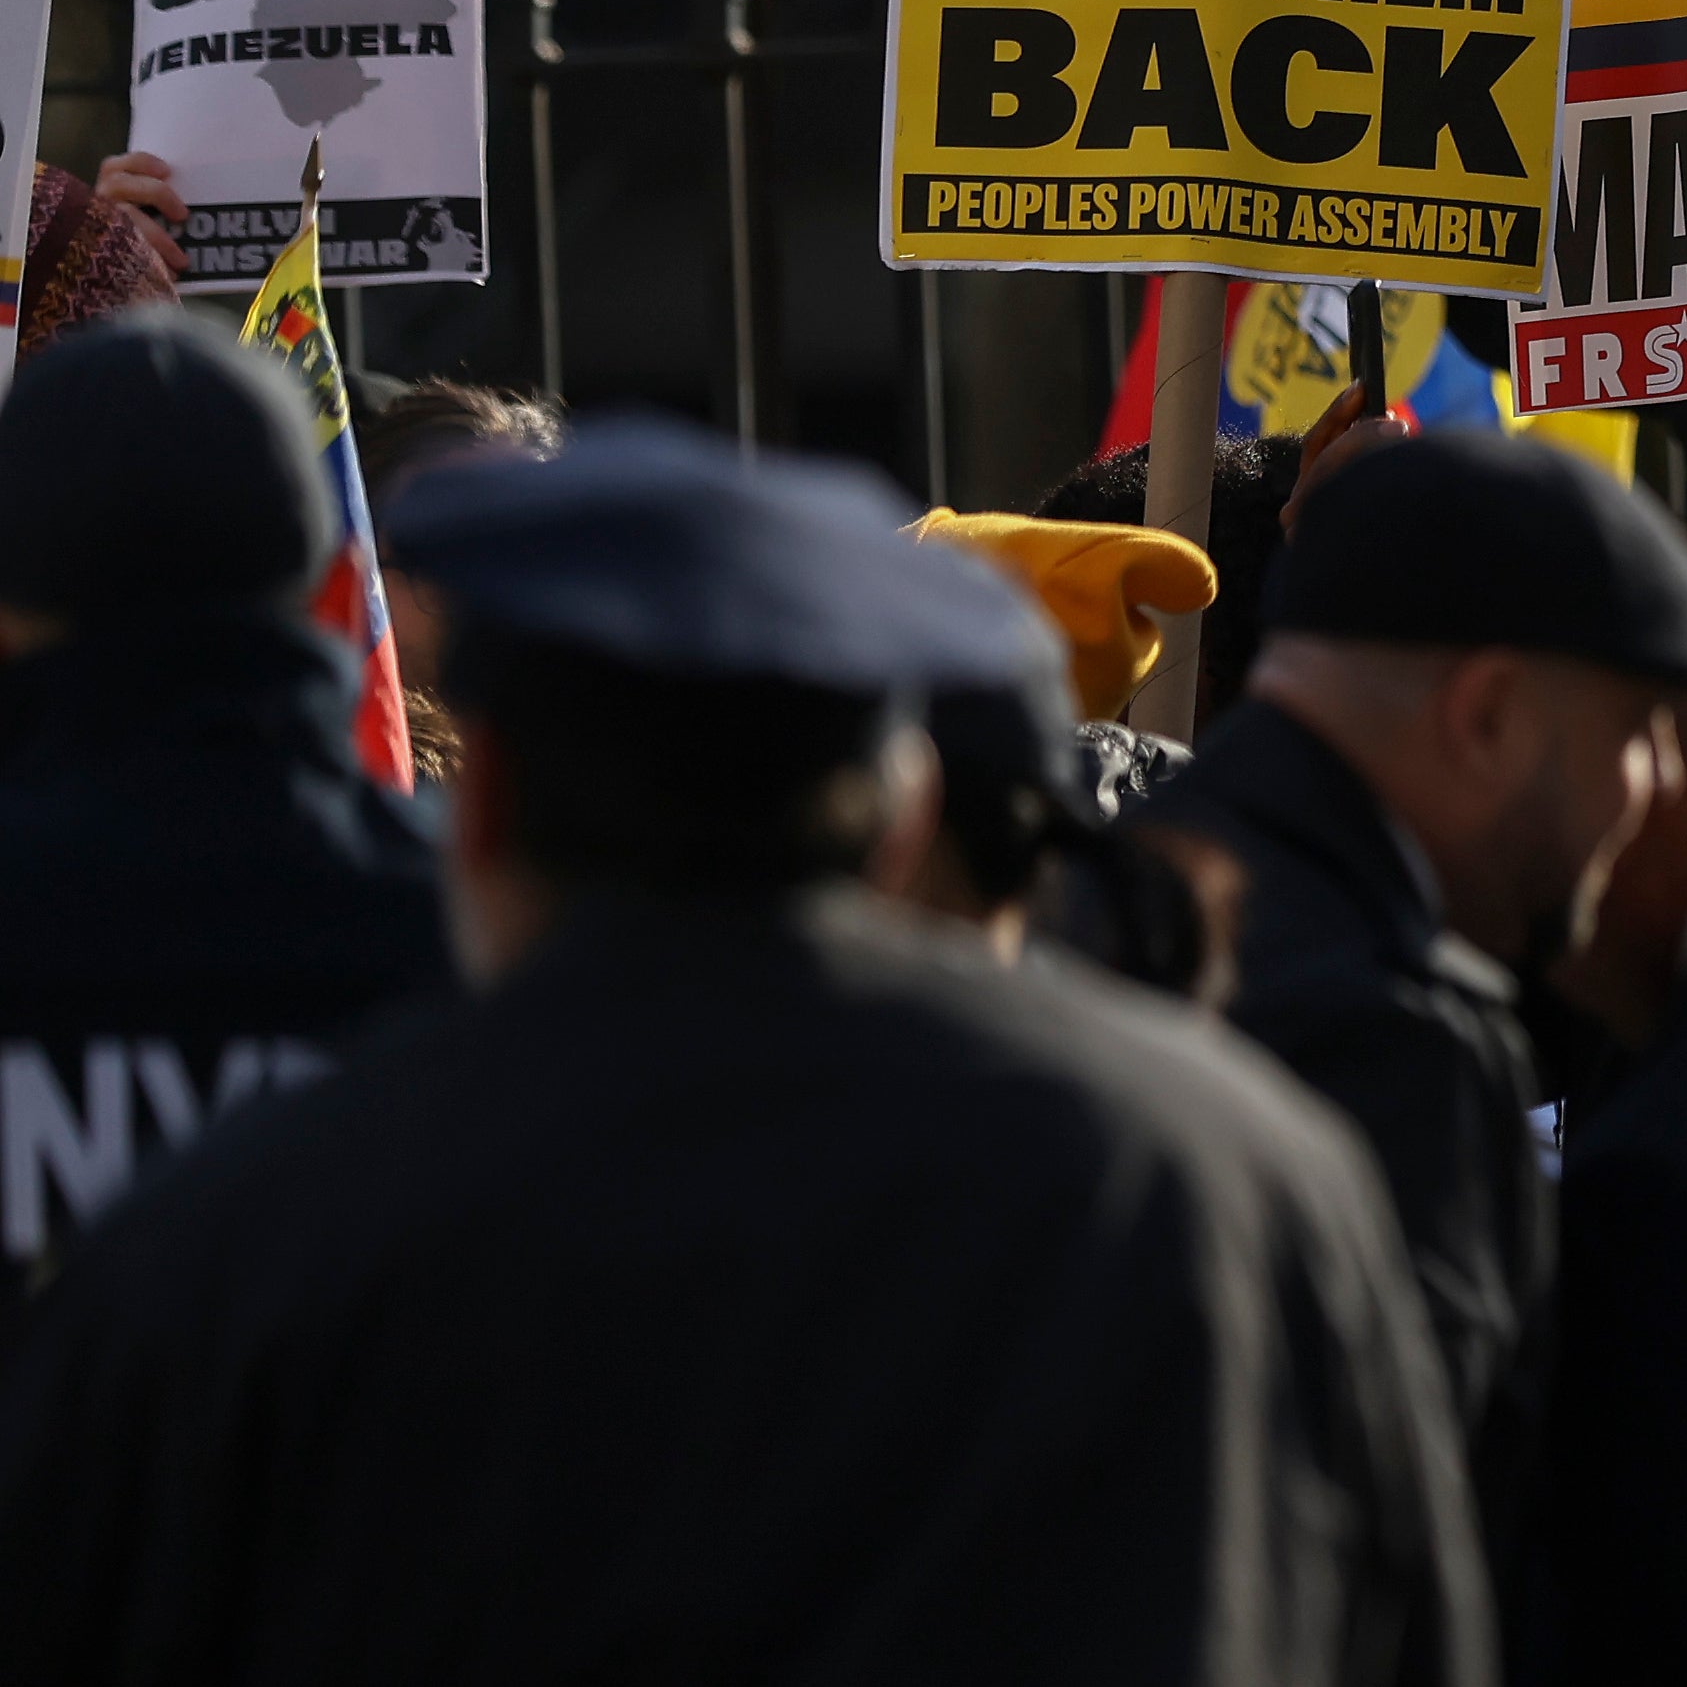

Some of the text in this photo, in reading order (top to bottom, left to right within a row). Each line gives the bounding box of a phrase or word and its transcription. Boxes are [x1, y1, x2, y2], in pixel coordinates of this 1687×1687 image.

[138, 24, 455, 84] VENEZUELA
[934, 7, 1536, 179] BACK
[927, 181, 1518, 258] PEOPLES POWER ASSEMBLY
[0, 1035, 343, 1261] NY
